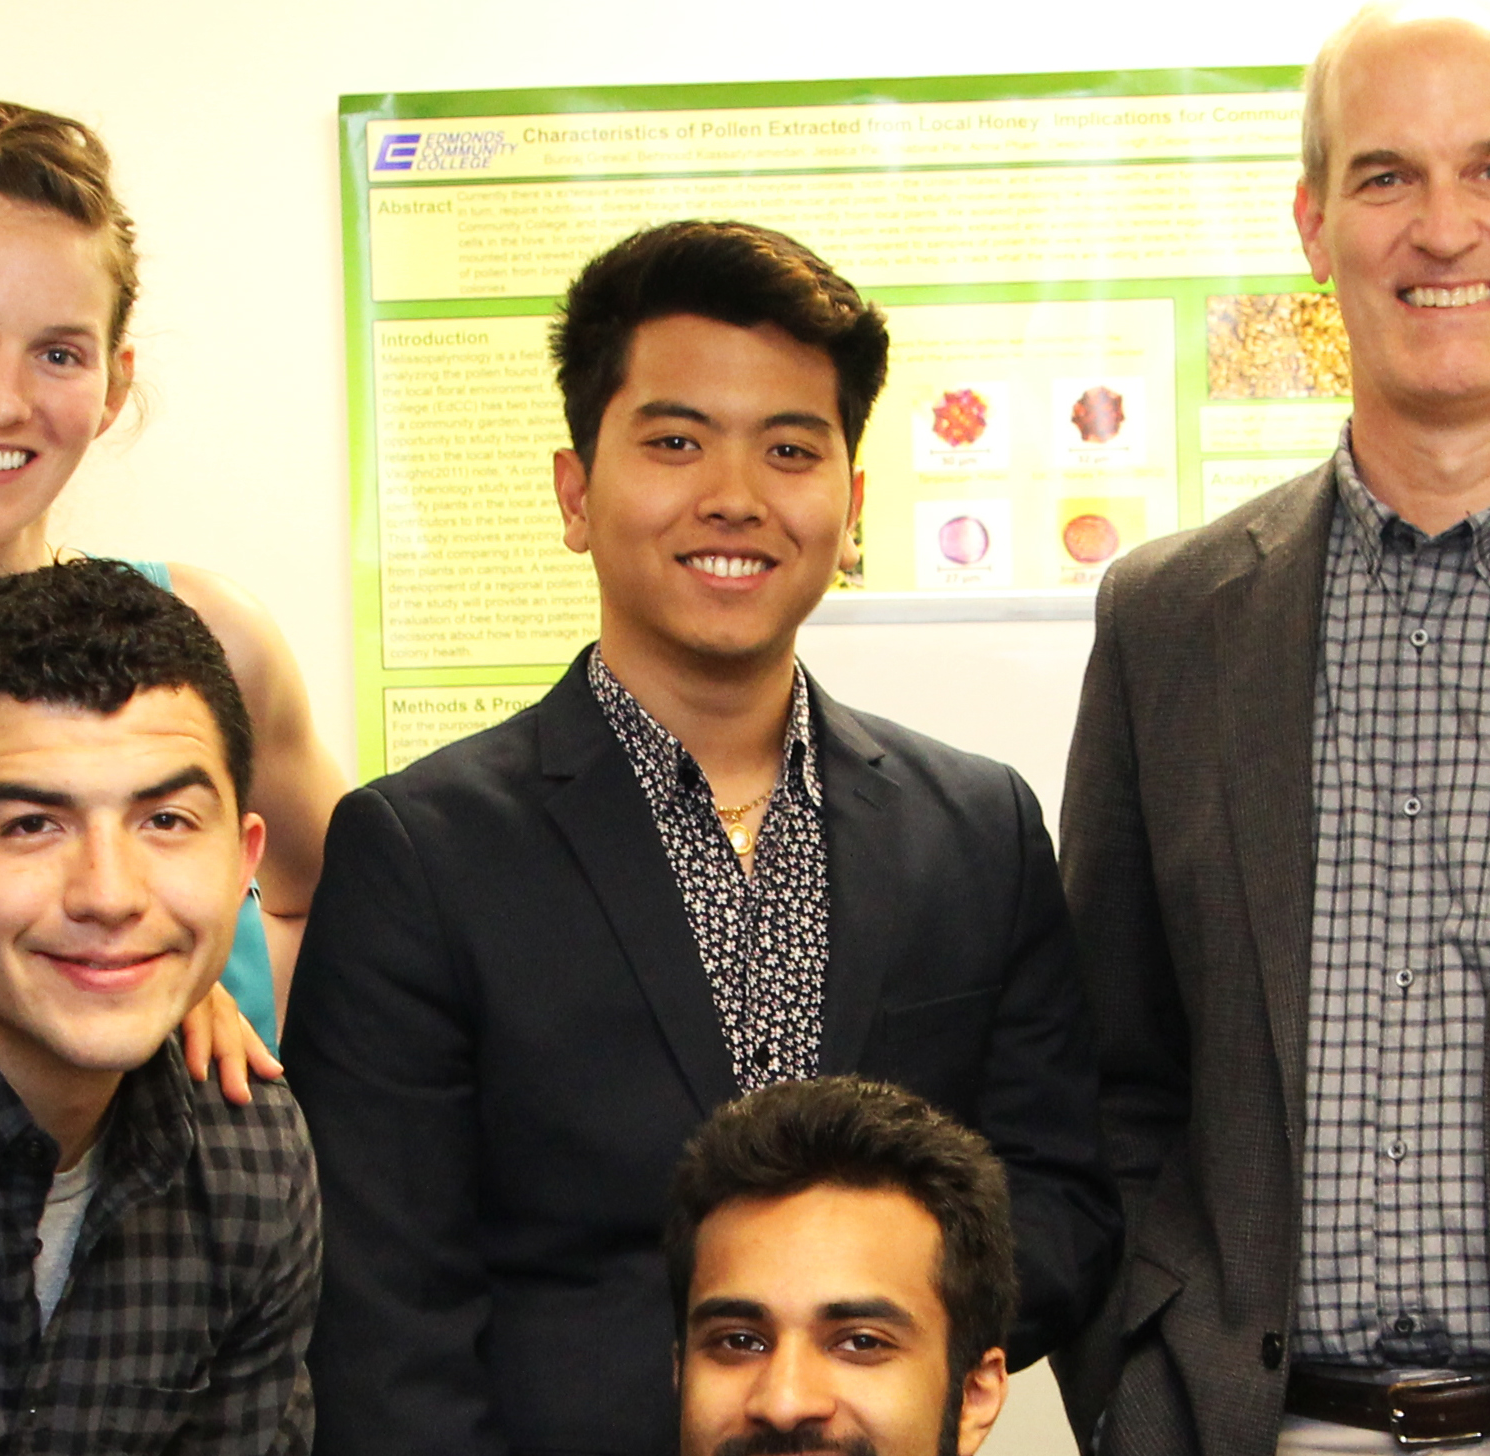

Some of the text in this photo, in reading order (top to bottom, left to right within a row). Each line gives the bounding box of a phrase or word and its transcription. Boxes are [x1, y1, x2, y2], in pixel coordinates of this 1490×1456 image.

[523, 126, 669, 143] Characteristics
[676, 123, 695, 139] of
[702, 121, 761, 138] Pollen
[769, 118, 861, 136] Extracted
[868, 116, 912, 133] from
[919, 115, 971, 132] Local
[1054, 109, 1171, 130] Implications
[1180, 108, 1206, 123] for
[425, 131, 505, 146] EDMONDS
[421, 141, 519, 159] COMMUNITY
[417, 156, 491, 171] COLLEGE
[378, 200, 452, 215] Abstract
[381, 331, 489, 347] Introduction
[392, 699, 468, 714] Methods
[474, 698, 486, 711] &
